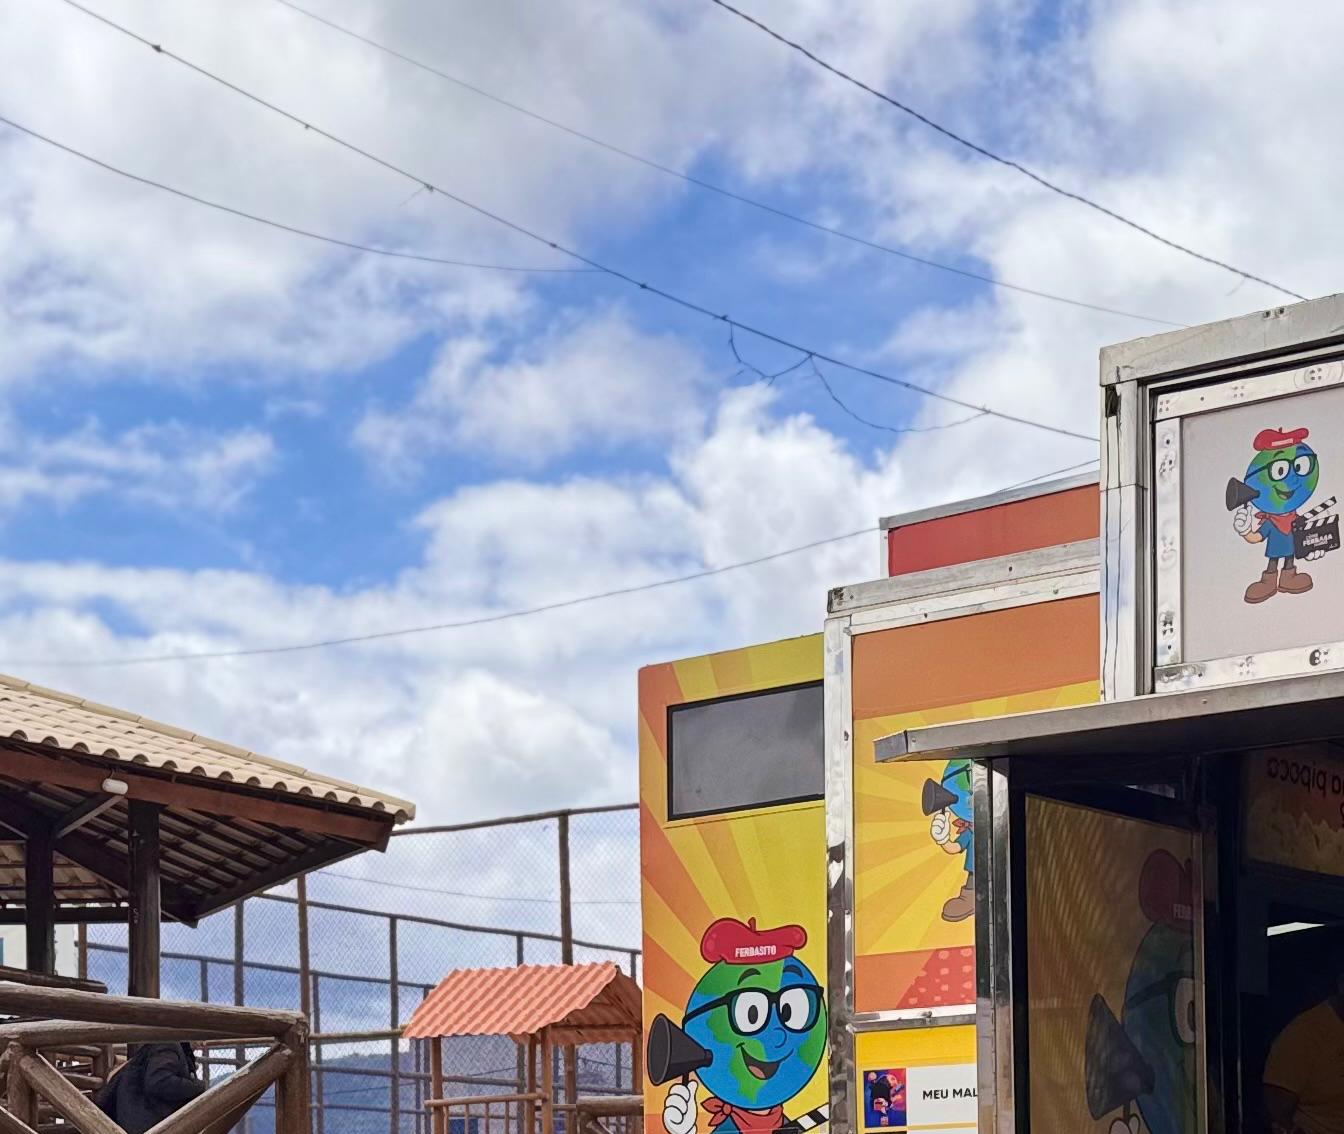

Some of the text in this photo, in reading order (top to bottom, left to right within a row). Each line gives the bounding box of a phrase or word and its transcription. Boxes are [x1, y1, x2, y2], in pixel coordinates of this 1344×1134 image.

[735, 945, 777, 958] FERBASITO
[922, 1087, 978, 1101] MEU MAL
